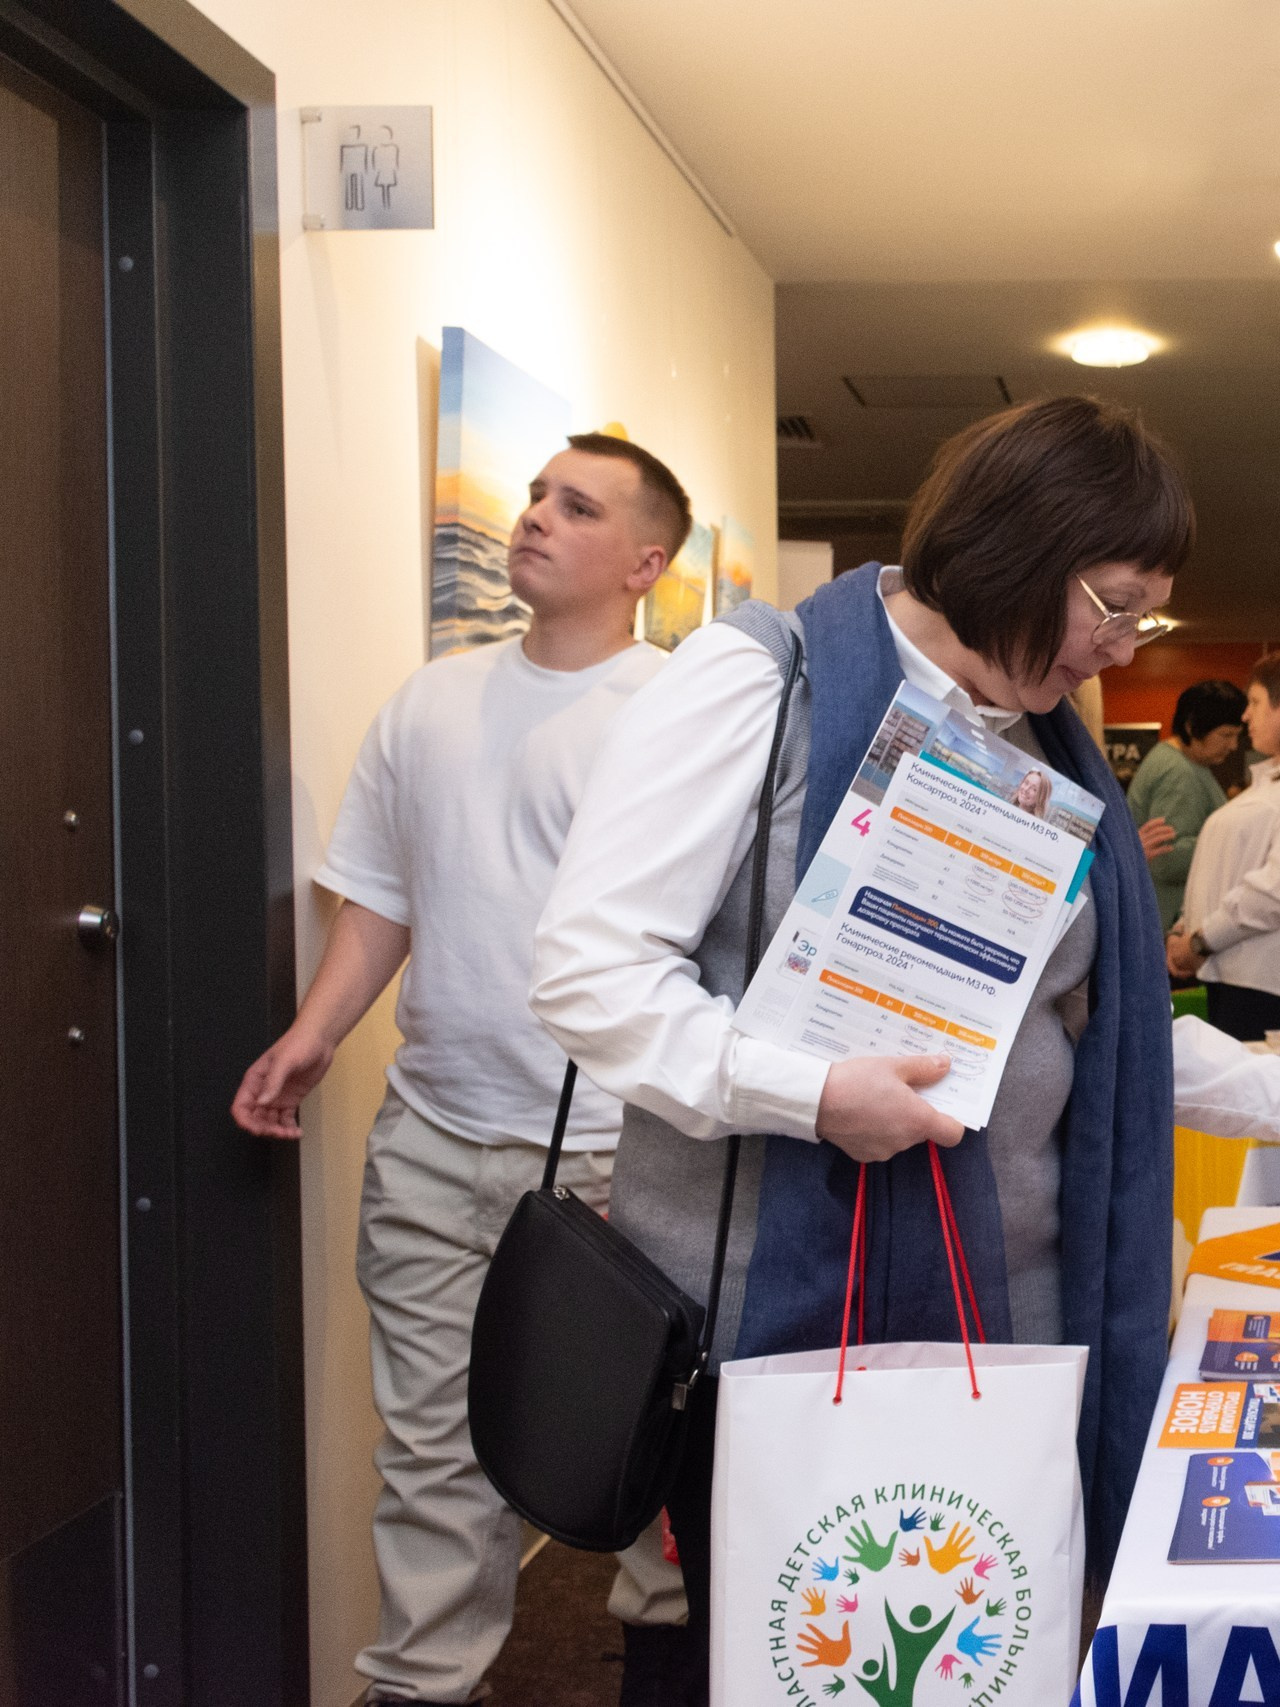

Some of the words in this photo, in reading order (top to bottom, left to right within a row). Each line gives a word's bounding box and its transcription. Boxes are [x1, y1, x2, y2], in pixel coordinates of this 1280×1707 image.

[904, 772, 960, 807] Коксартроз.
[958, 798, 982, 816] 2024
[909, 762, 969, 798] Клинические
[967, 790, 1031, 828] рекомендации
[1029, 821, 1046, 835] МЗ
[856, 905, 890, 924] дозировку
[888, 919, 920, 939] препарата
[860, 897, 879, 910] Ваши
[877, 906, 907, 924] пациенты
[905, 918, 934, 936] получают
[864, 889, 893, 908] Назначая
[938, 923, 949, 933] Вы
[947, 928, 970, 942] можете
[969, 937, 985, 949] быть
[1008, 956, 1020, 966] что
[798, 939, 818, 958] Эр
[834, 932, 886, 962] Гонартроз.
[884, 953, 909, 971] 2024
[839, 922, 901, 955] Клинические
[898, 950, 966, 985] рекомендации
[964, 976, 981, 991] МЗ
[1169, 1391, 1207, 1434] НОВОЕ
[1198, 1391, 1225, 1434] ОТКРЫВАТЬ
[777, 1494, 867, 1592] ДЕТСКАЯ
[874, 1483, 1028, 1581] КЛИНИЧЕСКАЯ
[968, 1588, 1032, 1707] БОЛЬНИЦ
